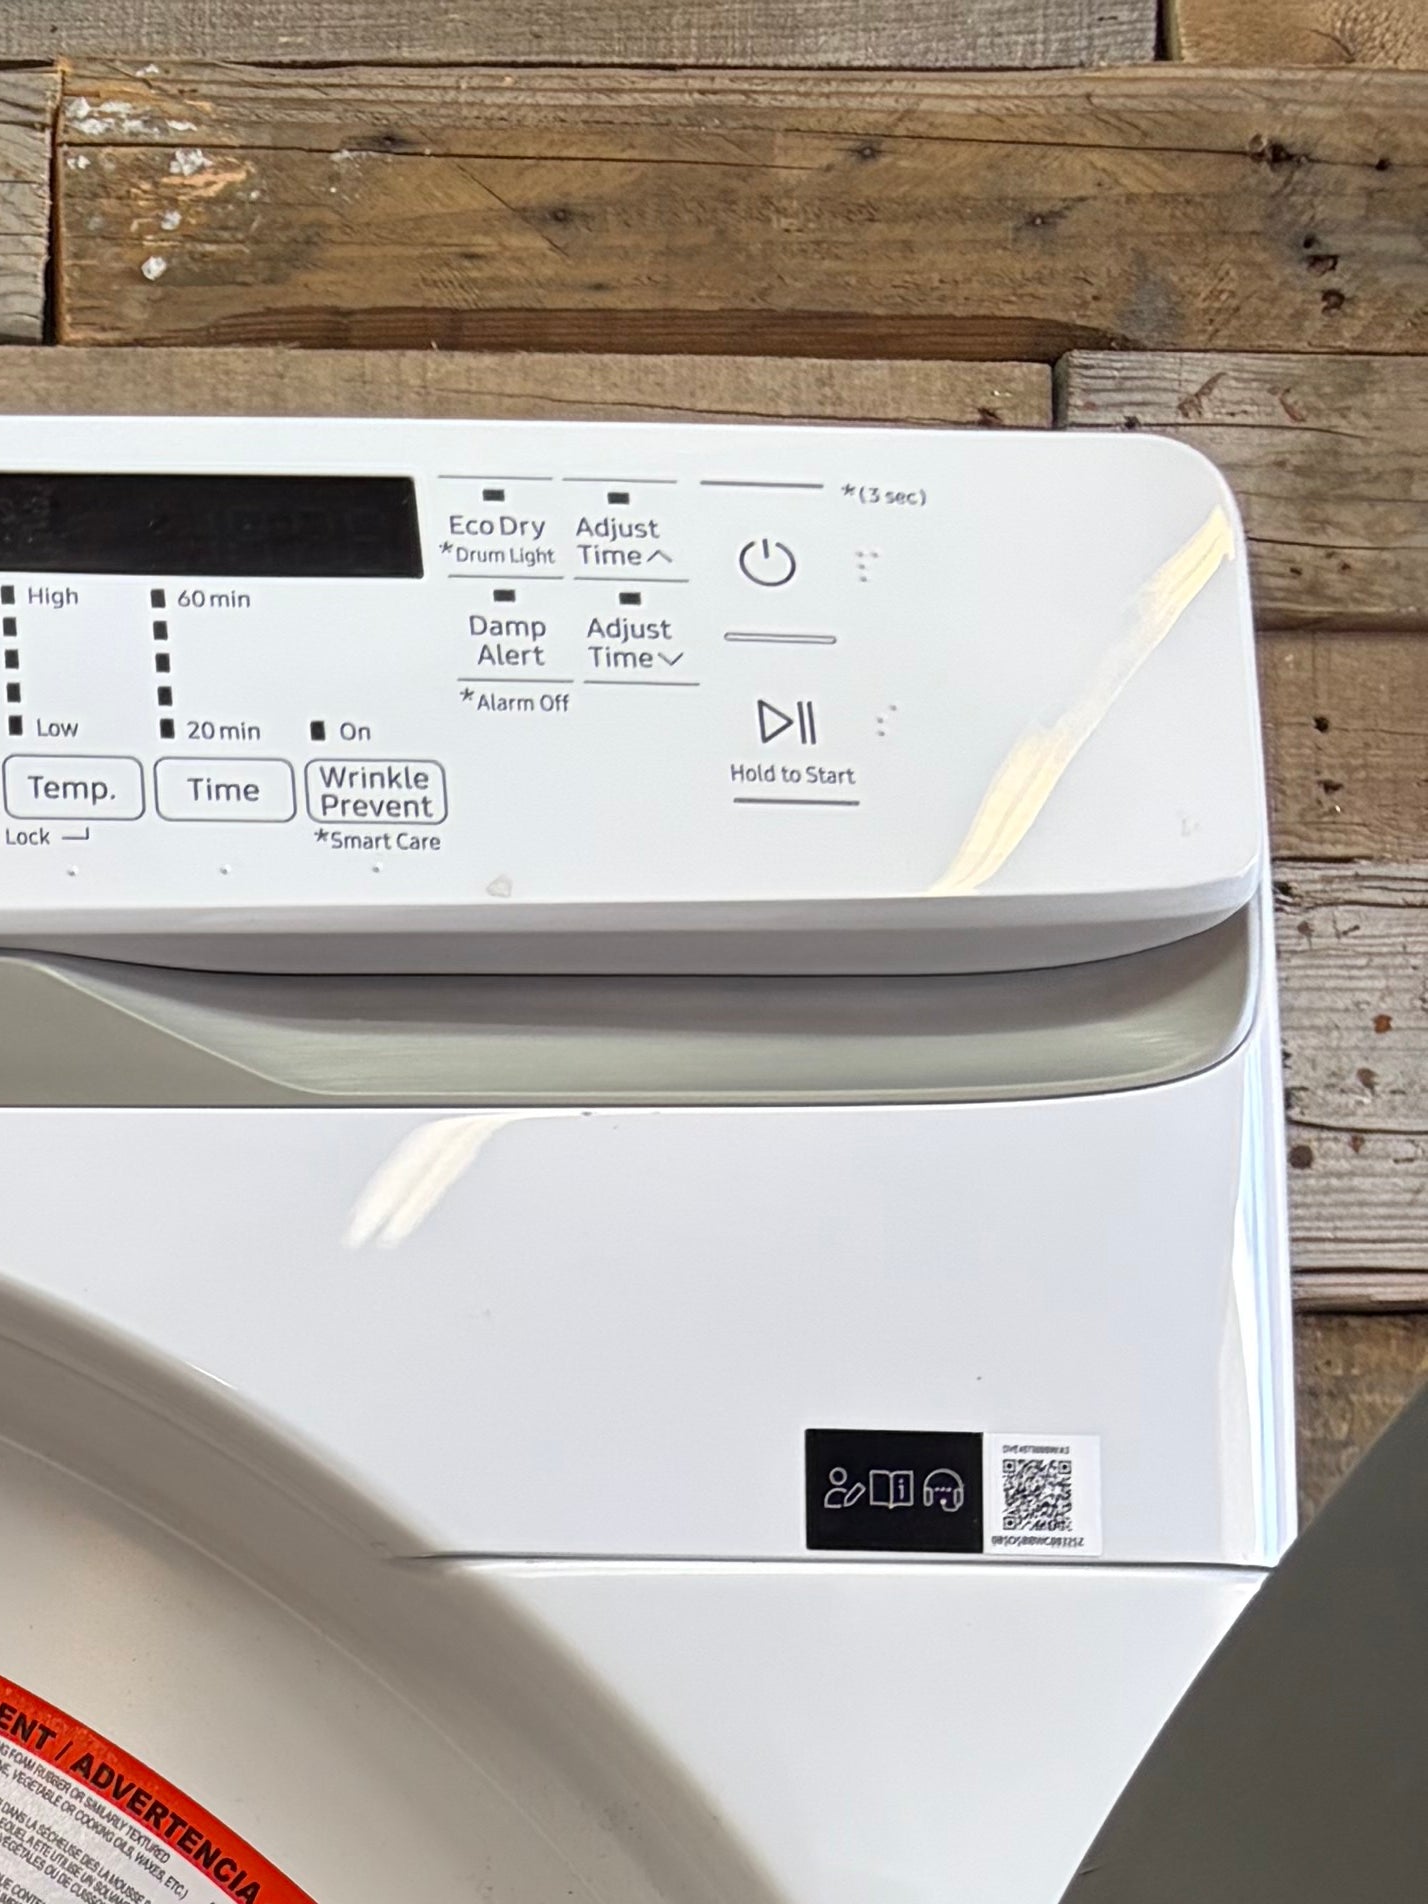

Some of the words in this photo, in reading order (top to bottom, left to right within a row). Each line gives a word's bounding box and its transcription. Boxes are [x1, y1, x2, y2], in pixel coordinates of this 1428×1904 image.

[885, 490, 926, 506] sec)
[450, 515, 494, 535] Eco
[500, 516, 545, 540] Dry
[576, 517, 660, 542] Adjust
[510, 548, 555, 567] Light
[577, 544, 641, 565] Time
[28, 587, 78, 609] High
[178, 590, 205, 607] 60
[210, 590, 250, 608] min
[469, 615, 546, 642] Damp
[587, 618, 672, 643] Adjust
[478, 644, 545, 666] Alert
[588, 646, 653, 668] Time
[540, 694, 569, 712] Off
[37, 718, 78, 737] Low
[187, 721, 215, 739] 20
[220, 722, 260, 740] min
[340, 722, 371, 741] On
[319, 766, 429, 790] Wrinkle
[731, 764, 775, 782] Hold
[781, 767, 801, 783] to
[806, 766, 856, 784] Start
[28, 776, 115, 805] Temp.
[187, 778, 259, 801] Time
[319, 794, 433, 821] Prevent
[6, 827, 50, 845] Lock
[396, 832, 440, 850] Care
[54, 1740, 74, 1761] /
[8, 1748, 36, 1772] FOAM
[33, 1763, 71, 1794] RUBBER
[69, 1787, 86, 1804] OR
[125, 1825, 171, 1864] TEXTURED
